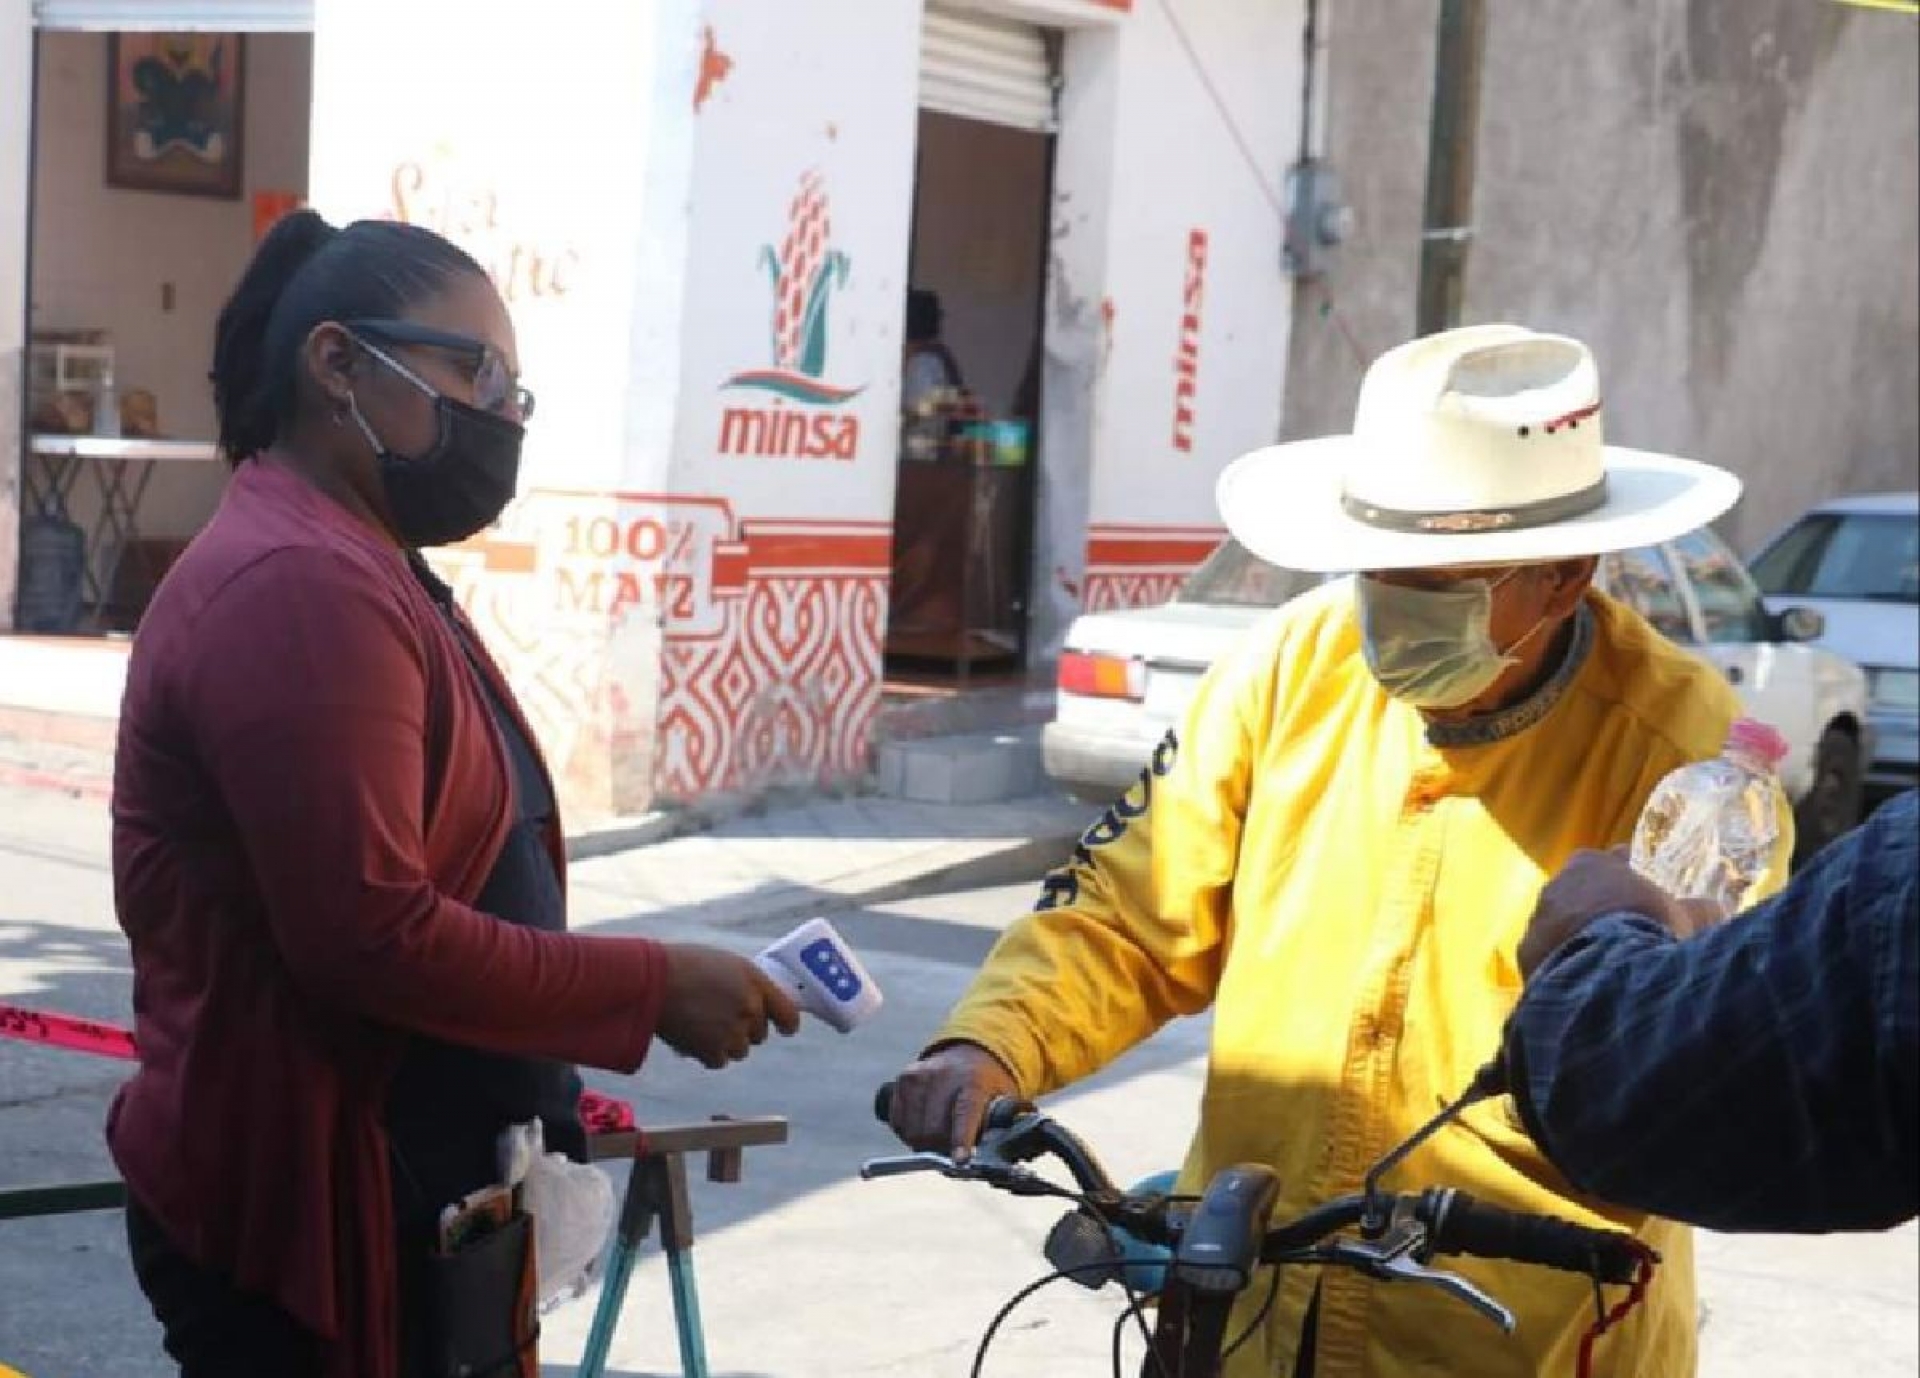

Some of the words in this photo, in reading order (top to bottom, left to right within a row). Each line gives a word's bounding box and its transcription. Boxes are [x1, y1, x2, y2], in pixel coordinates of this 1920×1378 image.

[1173, 229, 1207, 452] minsa
[718, 396, 859, 460] minsa
[562, 514, 698, 562] 100%
